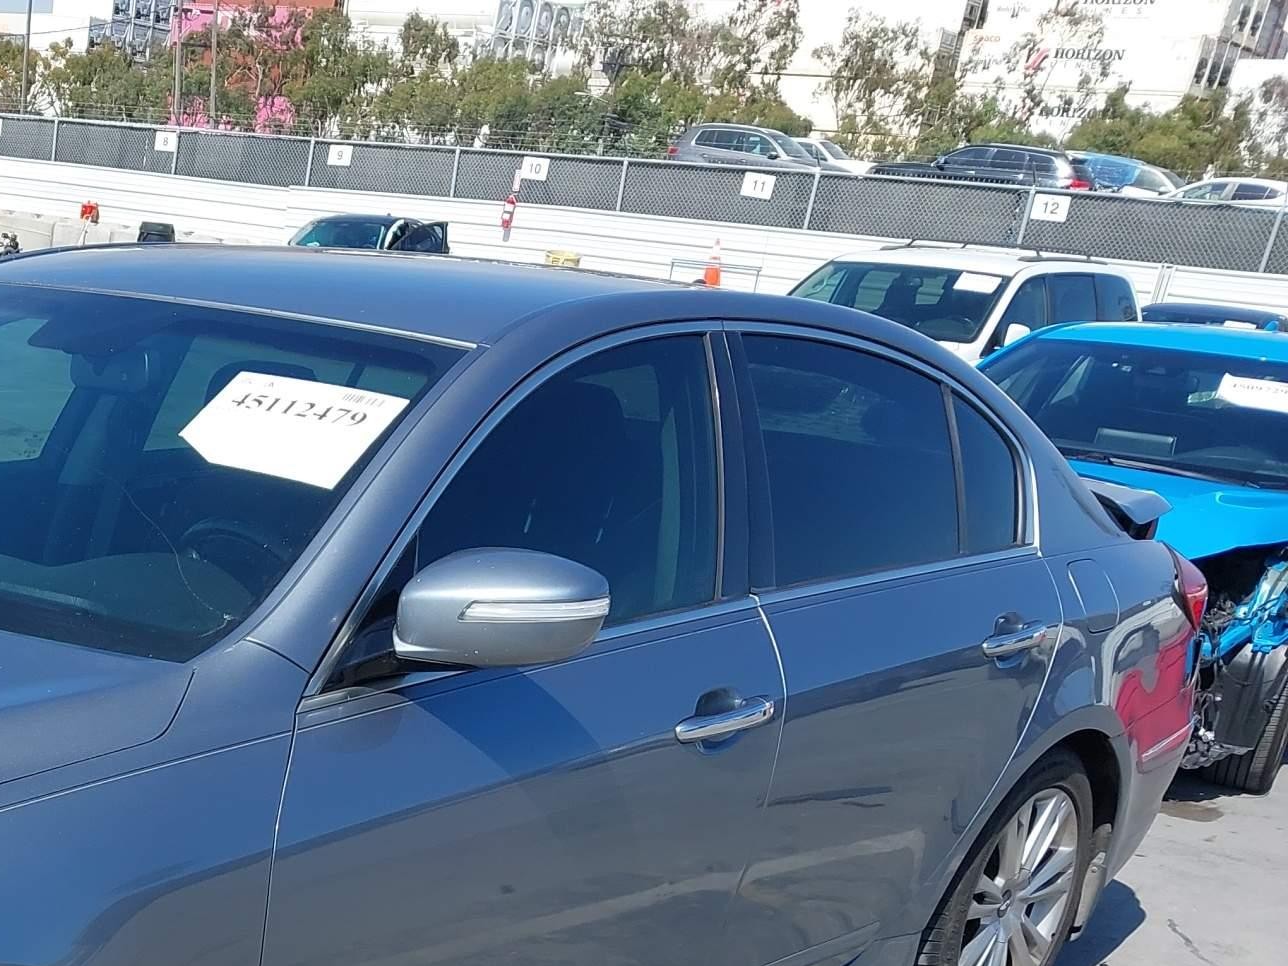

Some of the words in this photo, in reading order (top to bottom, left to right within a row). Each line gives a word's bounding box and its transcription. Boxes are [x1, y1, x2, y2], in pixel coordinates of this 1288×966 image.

[1053, 48, 1125, 61] HORIZON
[162, 136, 169, 146] 8
[337, 150, 344, 160] 9
[529, 162, 542, 175] 10
[753, 179, 766, 193] 11
[1042, 200, 1060, 215] 12
[232, 391, 368, 427] 45112479
